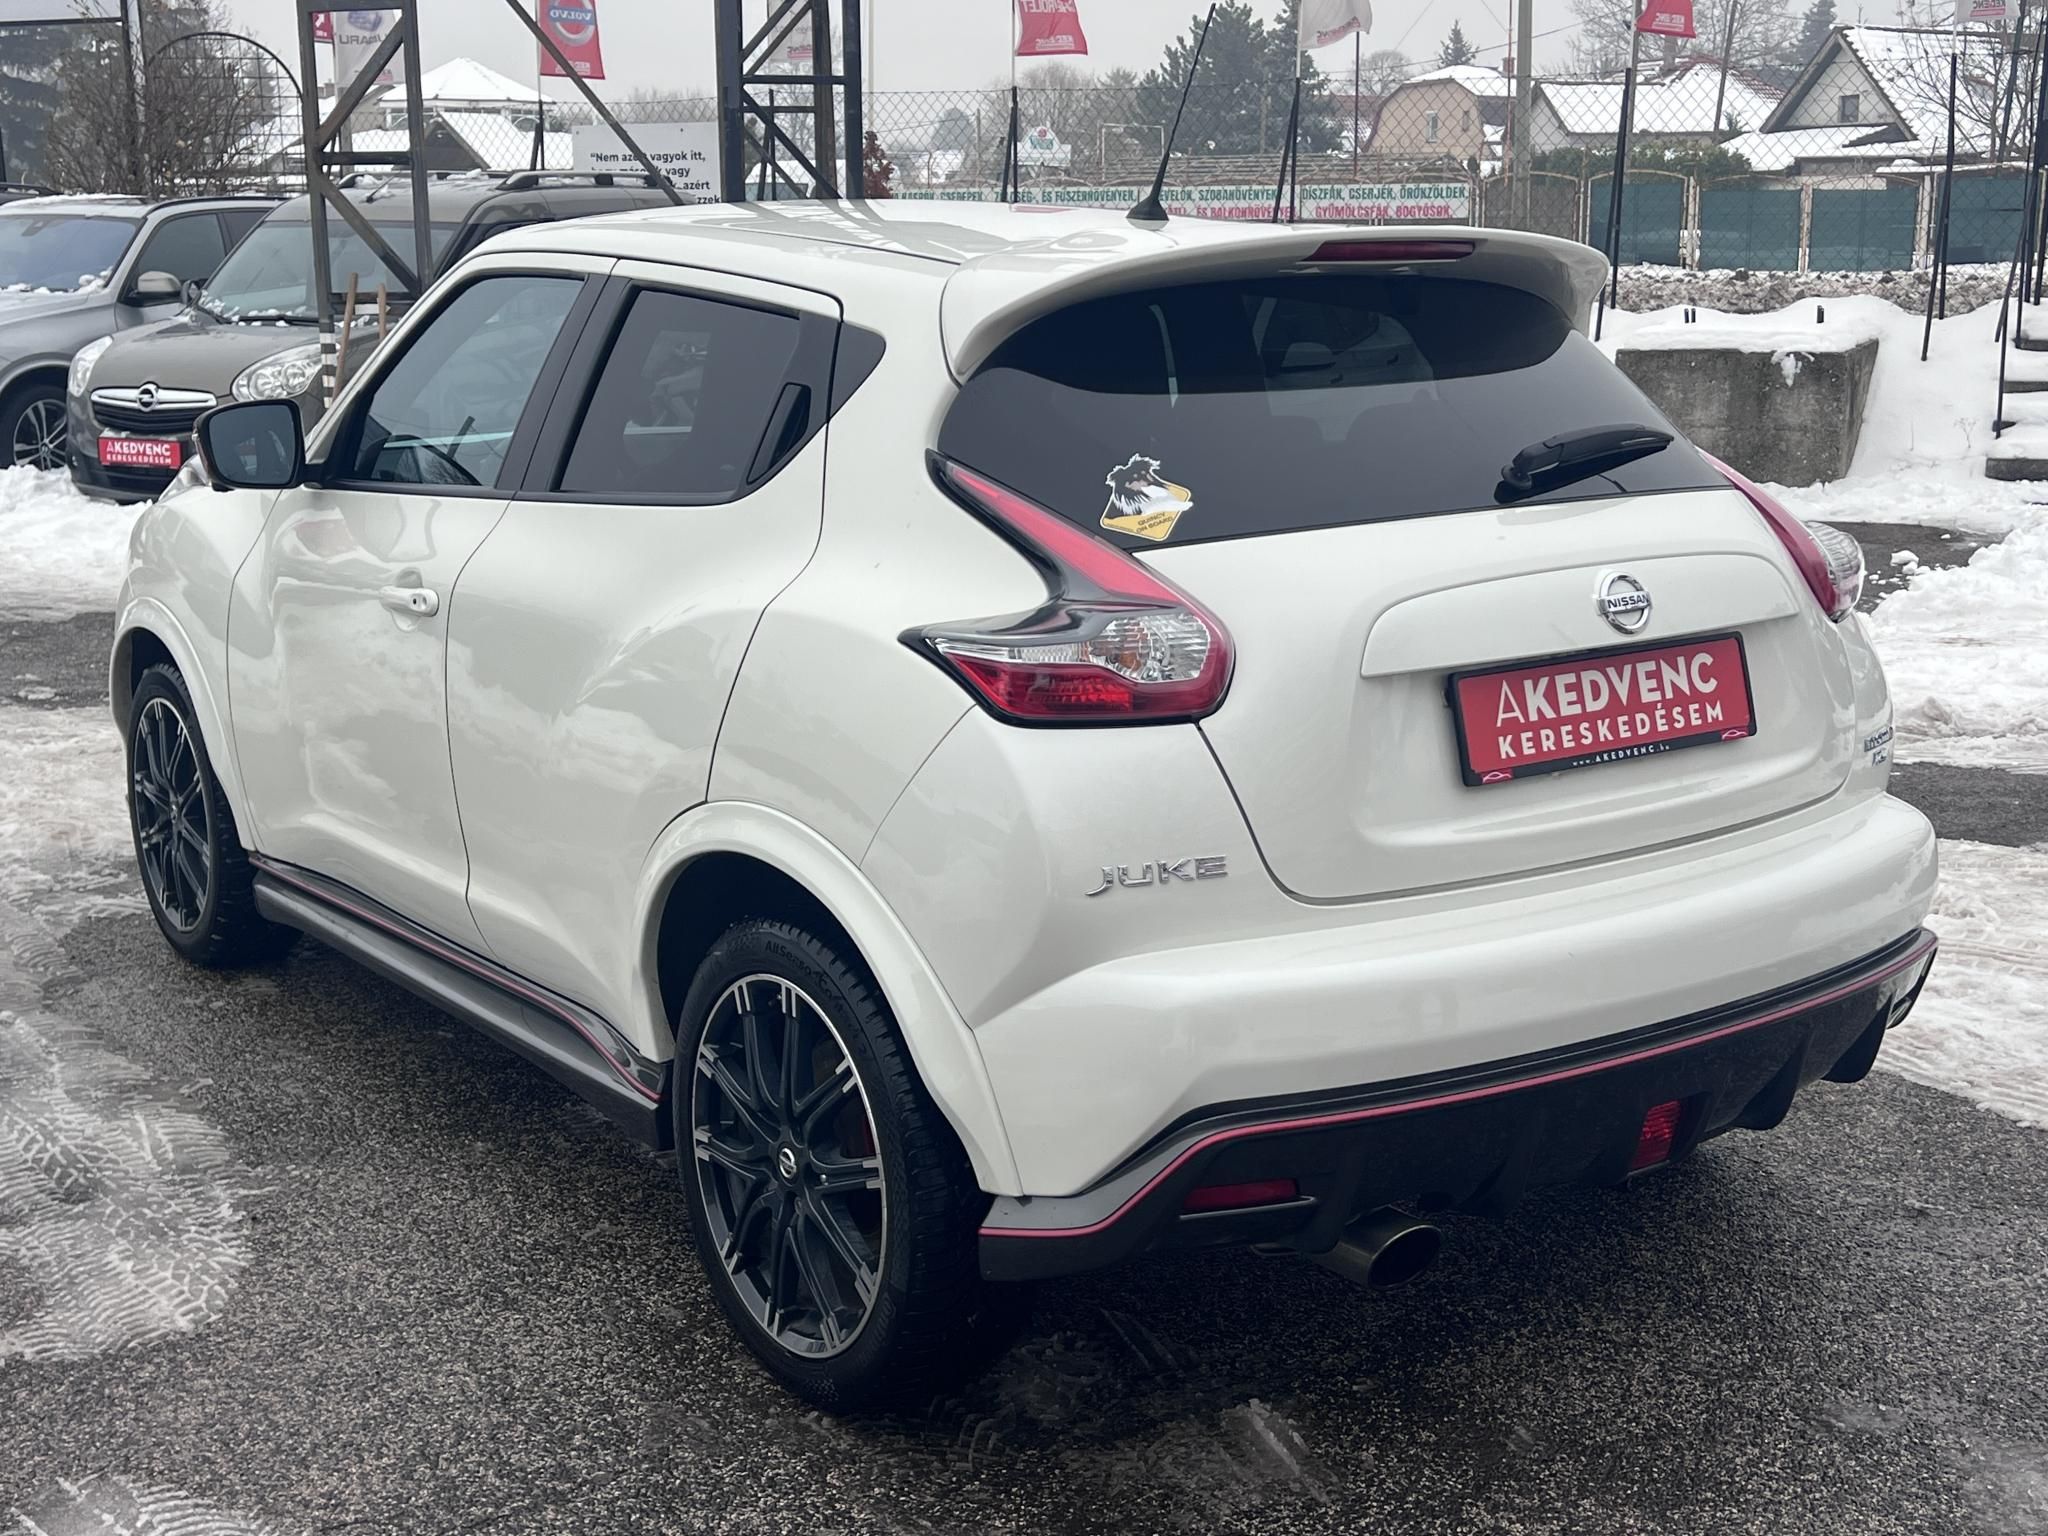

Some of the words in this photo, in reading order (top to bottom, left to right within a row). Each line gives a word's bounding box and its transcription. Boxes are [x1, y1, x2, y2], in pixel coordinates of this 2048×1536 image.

[650, 150, 688, 163] vagyok
[690, 149, 706, 162] itt,
[665, 167, 691, 178] vagy
[683, 179, 711, 190] azért
[106, 441, 171, 456] AKEDVENC
[1607, 593, 1650, 609] NISSAN
[1496, 652, 1719, 728] AKEDVENC
[1498, 700, 1724, 760] KERESKEDÉSEM
[1085, 854, 1228, 897] JUKE
